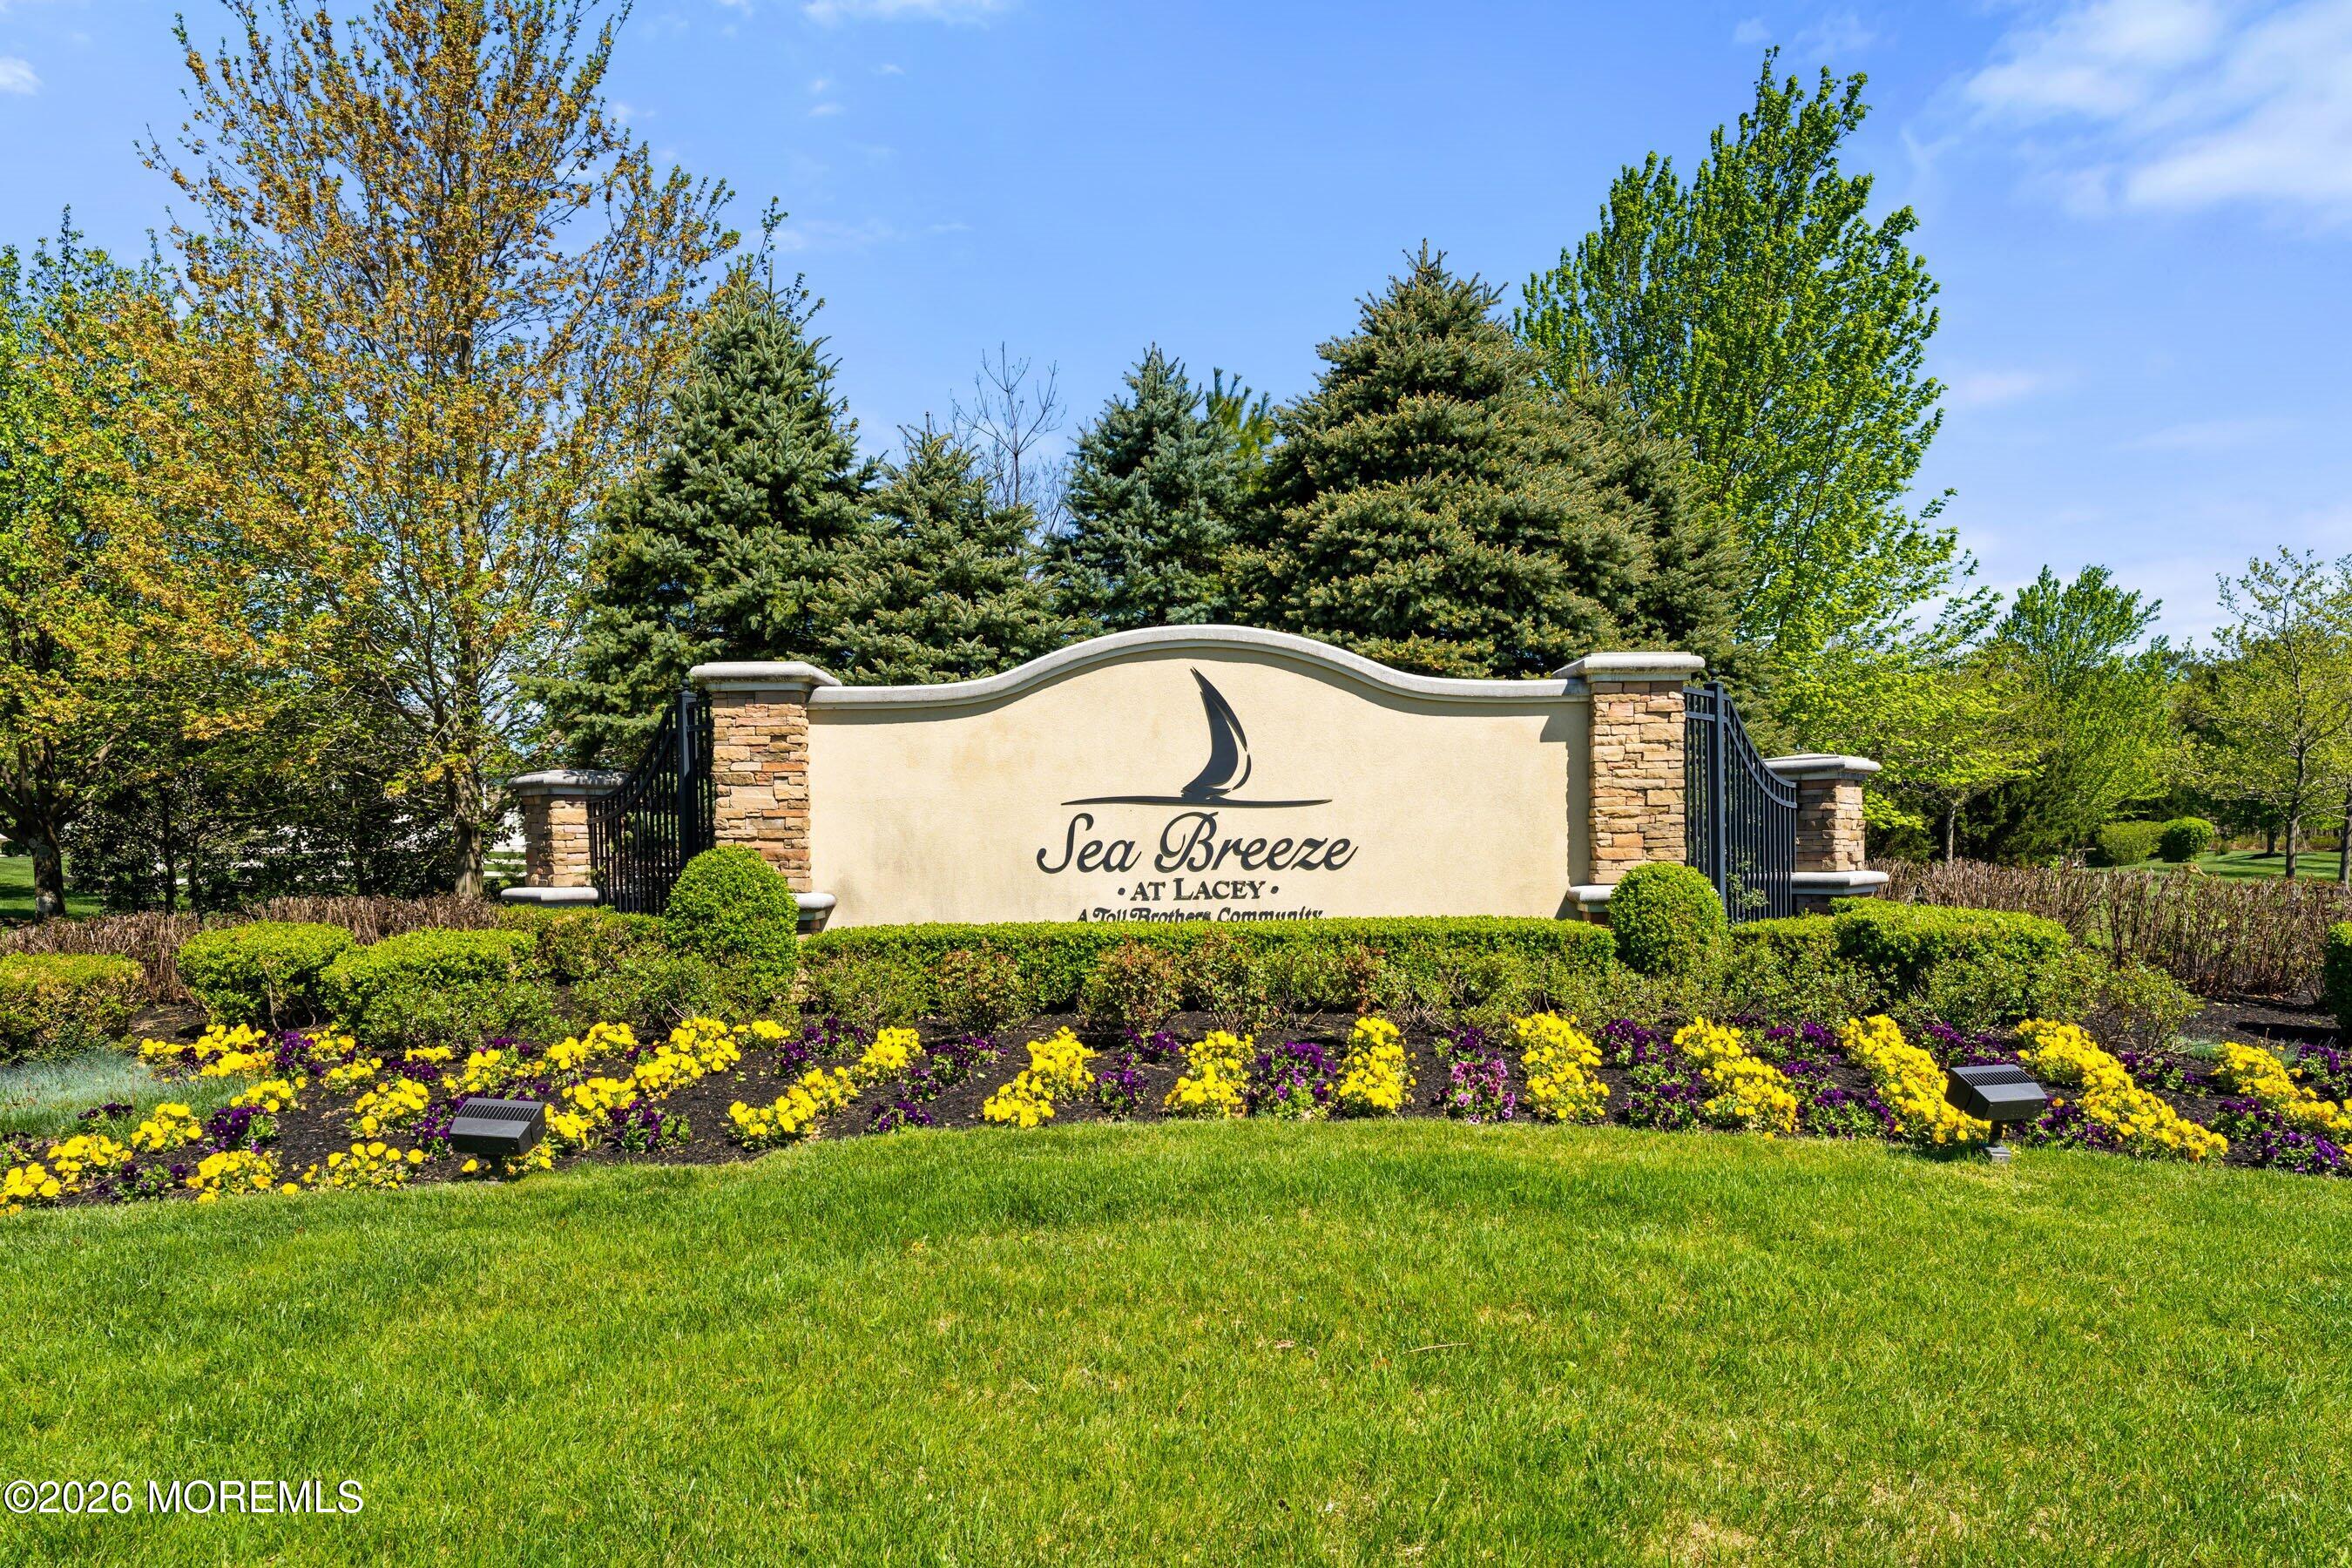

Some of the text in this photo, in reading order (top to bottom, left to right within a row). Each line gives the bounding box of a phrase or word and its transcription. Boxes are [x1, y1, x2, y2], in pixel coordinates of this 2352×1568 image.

[1037, 811, 1359, 874] Sea Breeze
[1130, 877, 1266, 901] AT LACEY
[1077, 909, 1088, 923] A
[1092, 907, 1127, 923] Toll
[1130, 907, 1211, 923] Brothers
